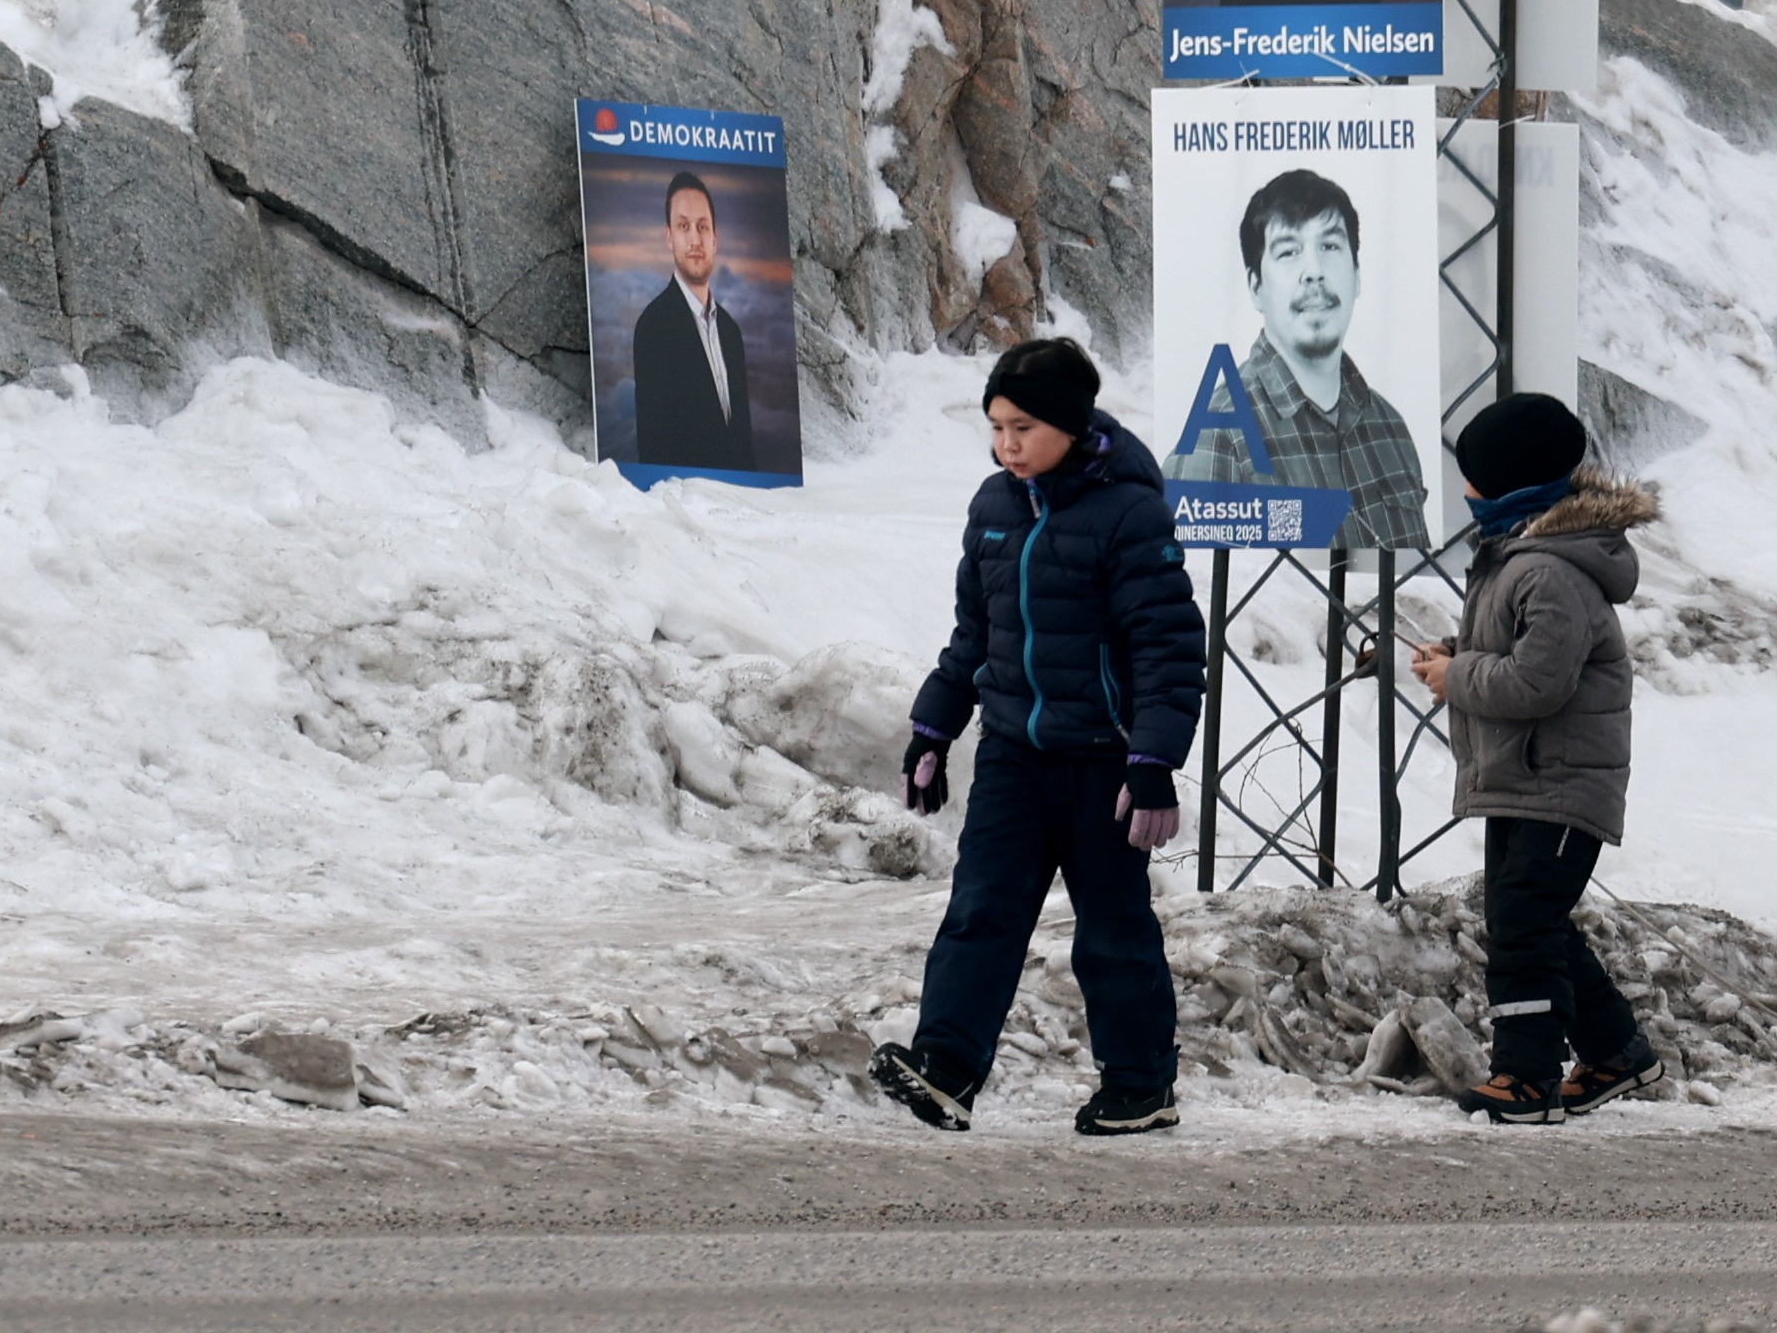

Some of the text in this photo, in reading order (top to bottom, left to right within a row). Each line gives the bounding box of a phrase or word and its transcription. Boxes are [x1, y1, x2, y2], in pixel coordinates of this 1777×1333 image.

[1170, 24, 1435, 62] Jens-Frederik Nielsen
[630, 120, 775, 154] DEMOKRAATIT
[1173, 119, 1415, 152] HANS FREDERIK MØLLER
[1174, 343, 1275, 475] A
[1174, 495, 1263, 523] Atassut
[1235, 524, 1263, 542] 2025
